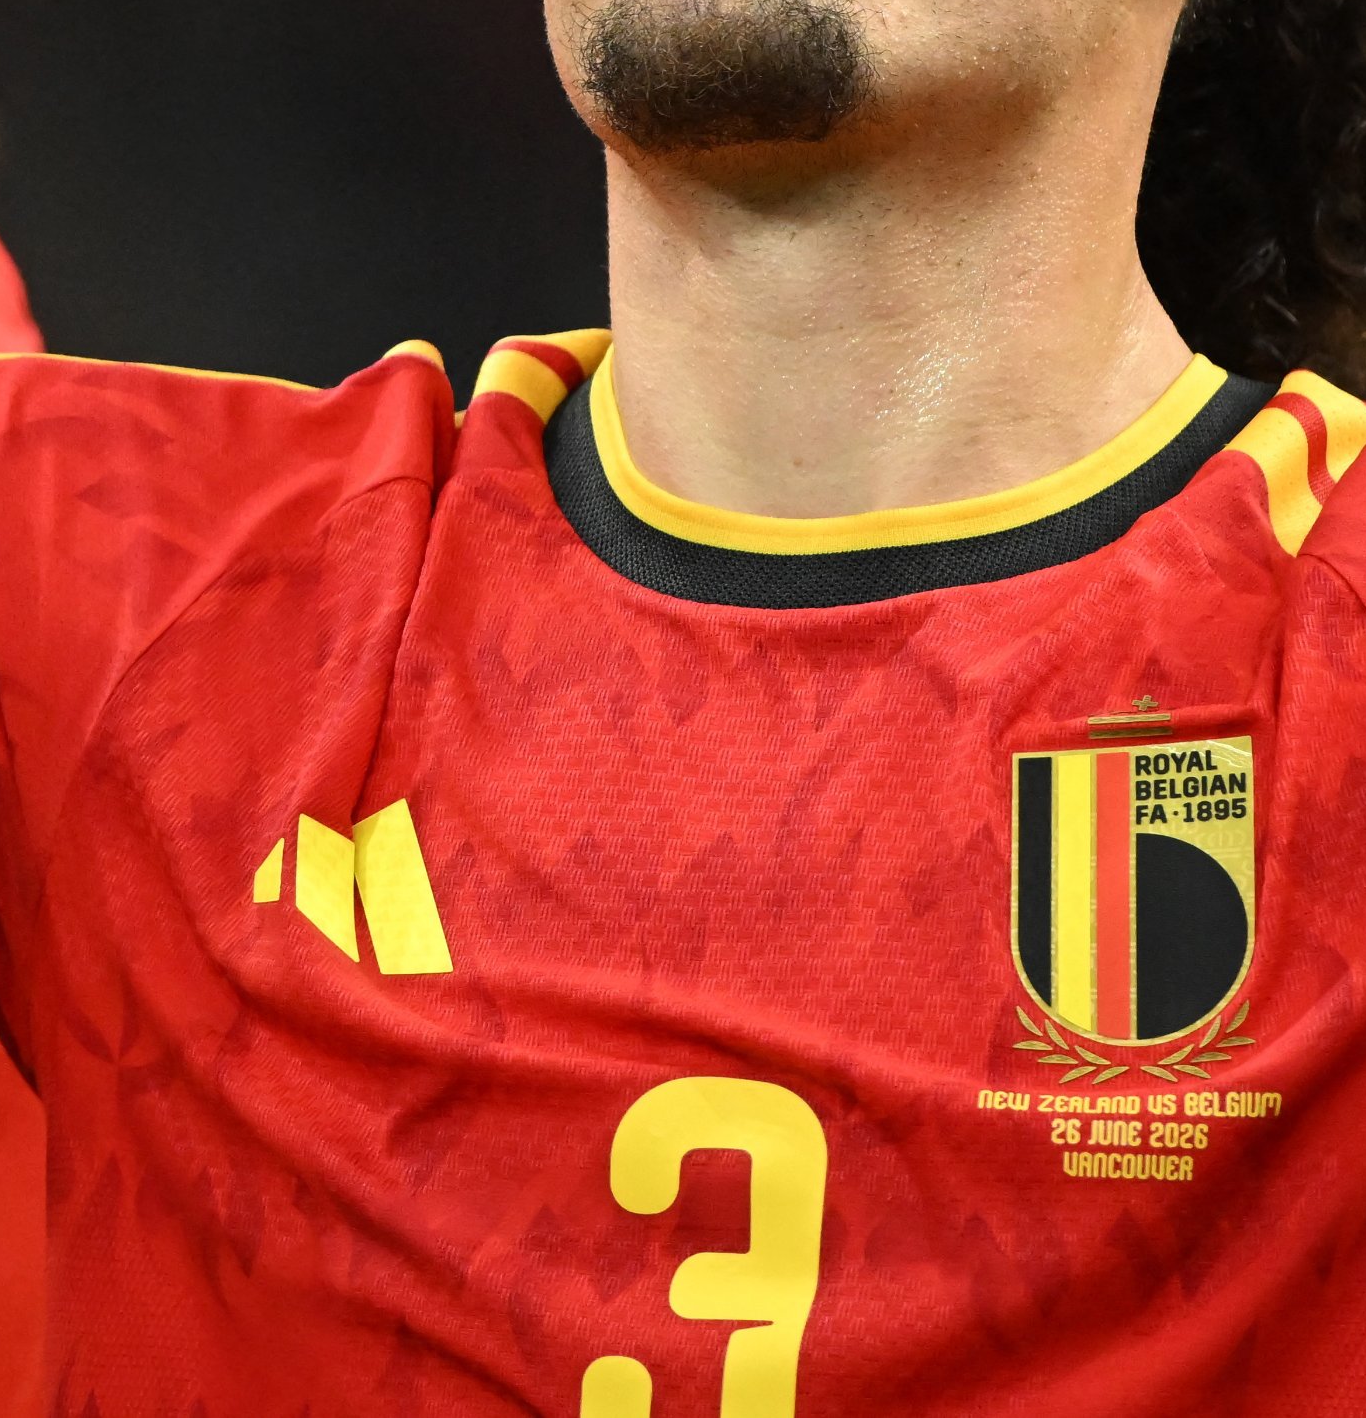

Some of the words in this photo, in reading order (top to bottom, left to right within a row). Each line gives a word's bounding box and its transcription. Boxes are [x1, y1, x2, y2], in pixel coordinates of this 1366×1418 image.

[1135, 750, 1218, 776] ROYAL
[1135, 772, 1246, 801] BELGIAN
[977, 1089, 1031, 1111] NEW
[1037, 1094, 1141, 1114] ZEALAND
[1184, 1091, 1282, 1118] BELGIUM
[1051, 1118, 1082, 1145] 26
[1087, 1119, 1143, 1147] JUNE
[1149, 1121, 1209, 1149] 2026
[1063, 1151, 1194, 1181] VANCOUVER
[579, 1076, 828, 1418] 3
